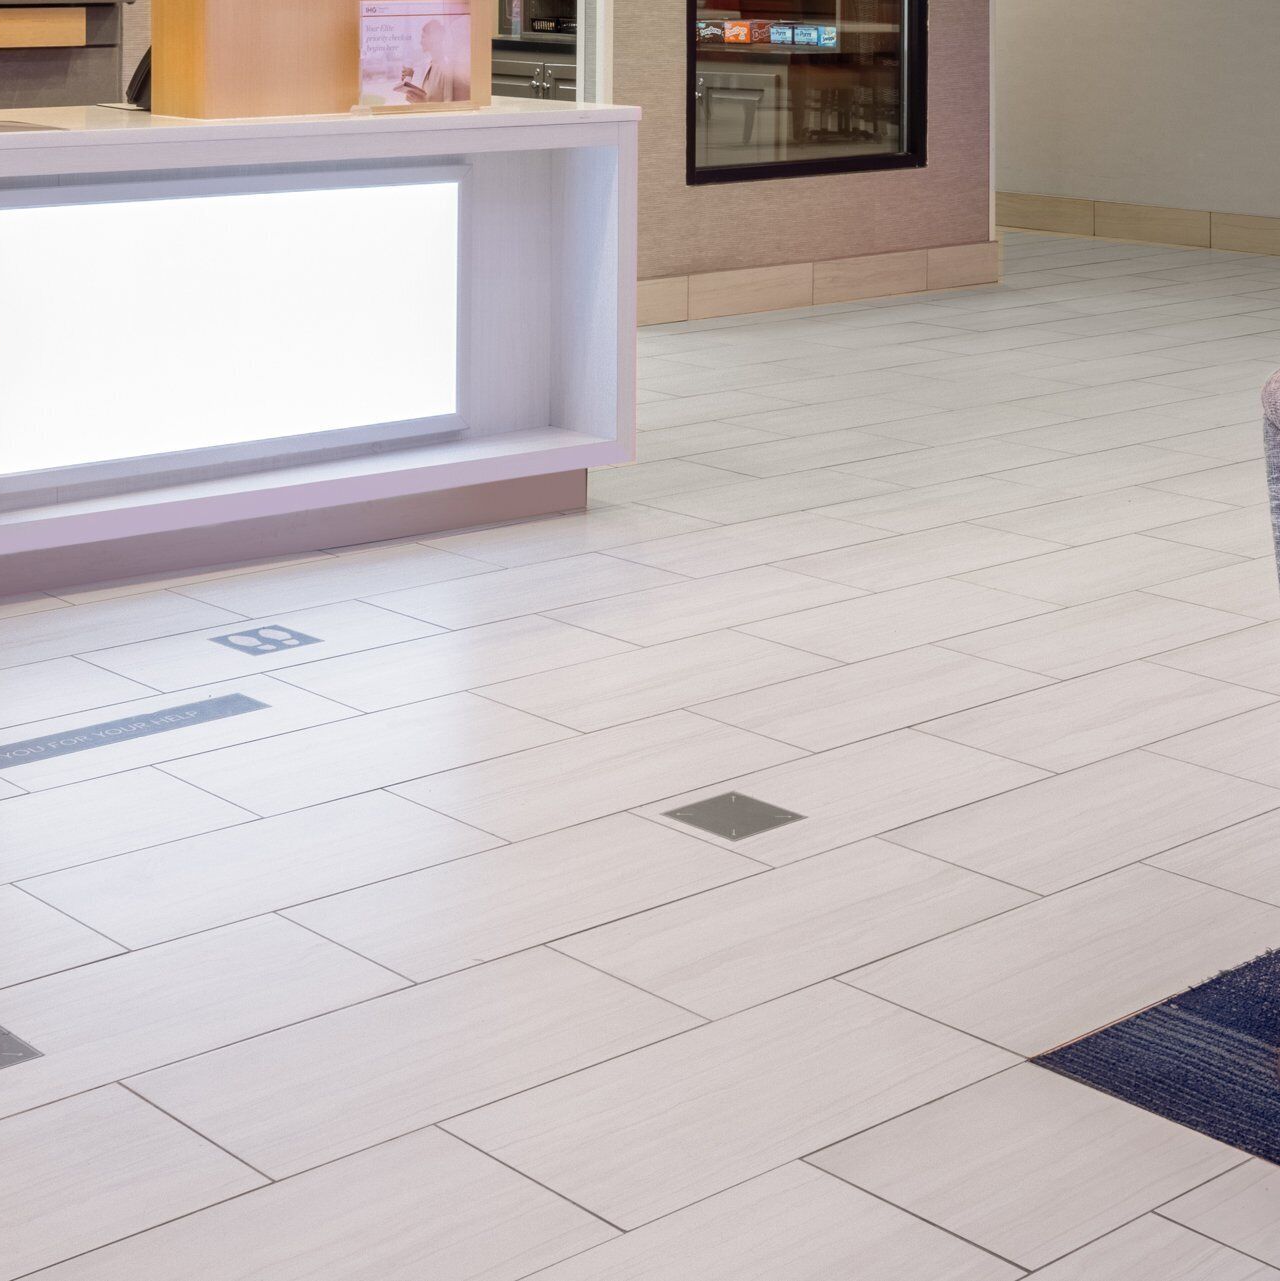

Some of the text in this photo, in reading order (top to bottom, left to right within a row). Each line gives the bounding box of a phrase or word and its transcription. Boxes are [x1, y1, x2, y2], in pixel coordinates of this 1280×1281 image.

[0, 744, 46, 760] YOU
[47, 735, 91, 750] FOR
[93, 722, 150, 739] YOUR
[148, 710, 201, 727] HELP
